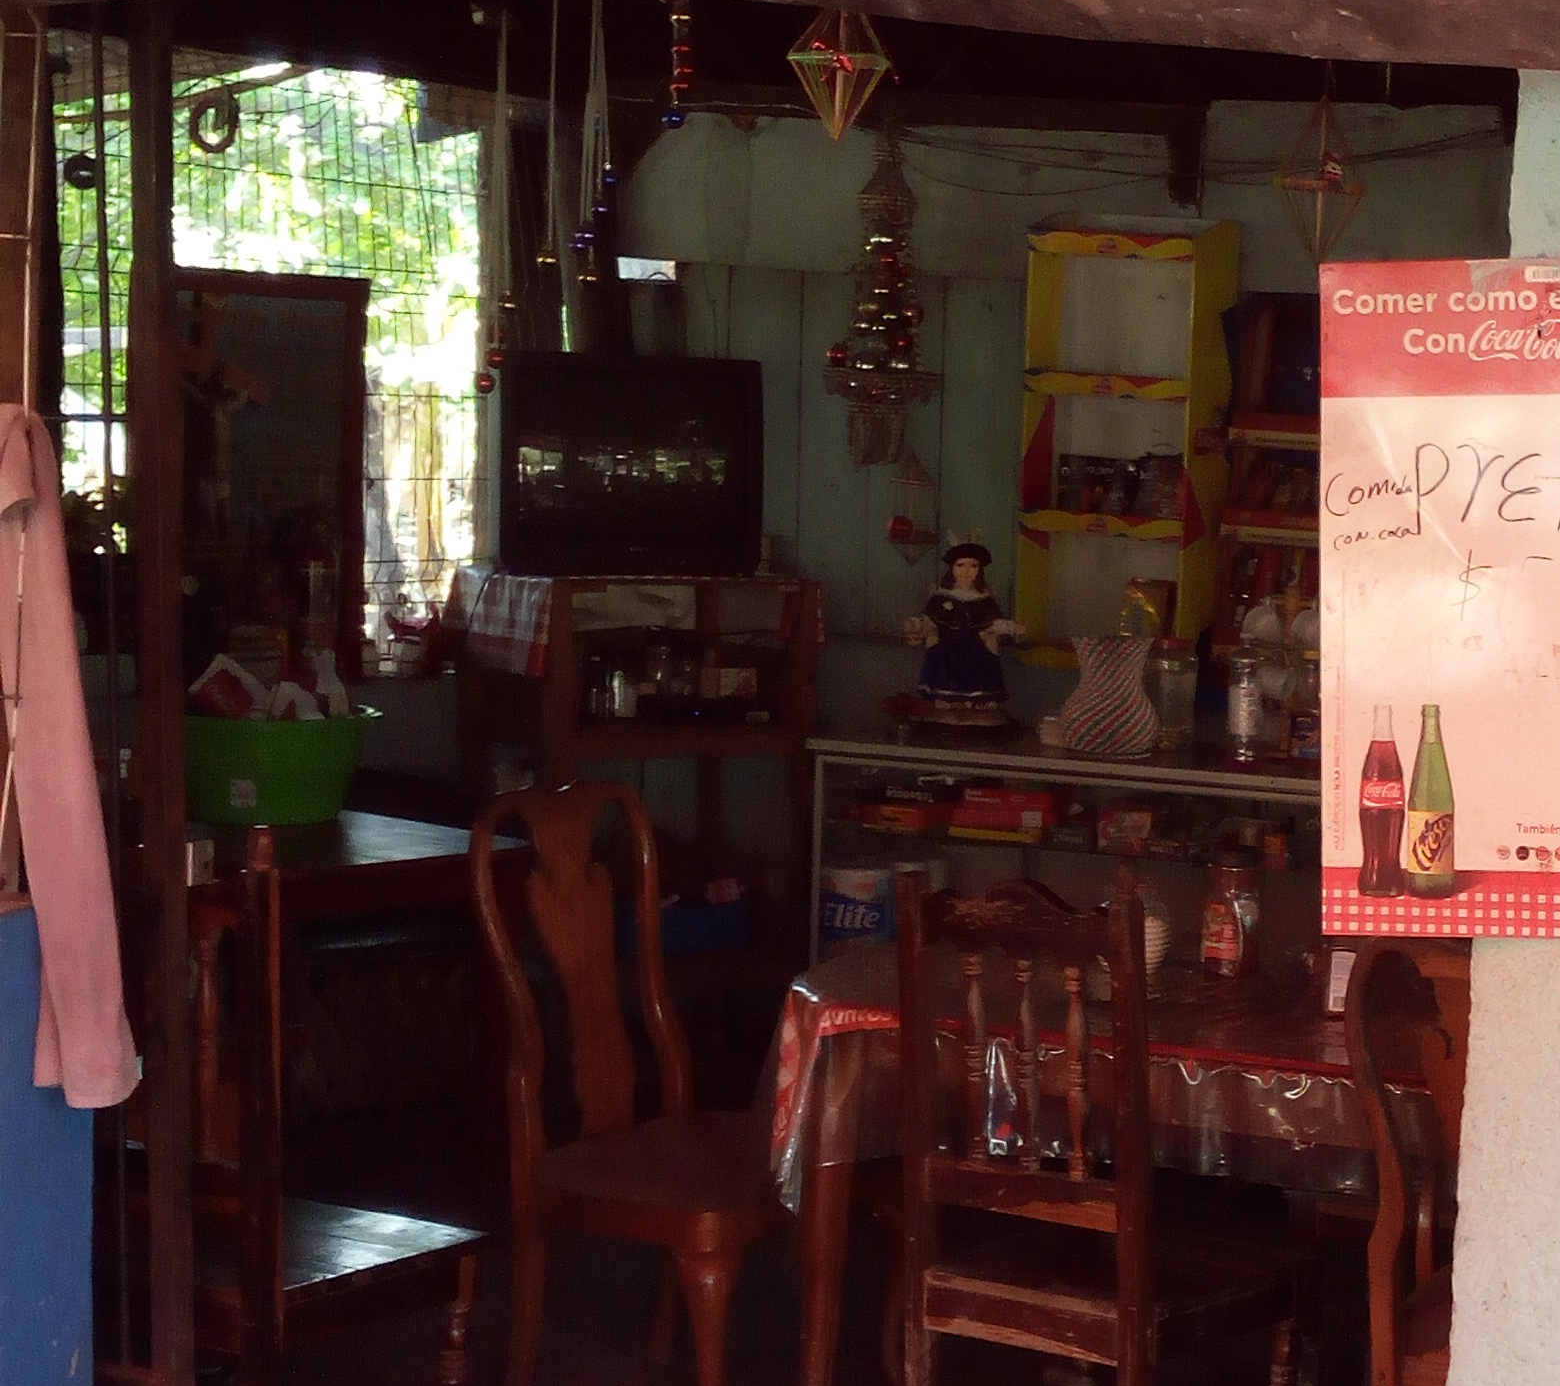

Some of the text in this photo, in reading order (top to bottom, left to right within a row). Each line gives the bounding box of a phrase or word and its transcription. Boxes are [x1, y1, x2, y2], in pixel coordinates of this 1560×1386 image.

[1332, 289, 1438, 315] Comer
[1449, 289, 1538, 312] como
[1403, 328, 1465, 355] Con
